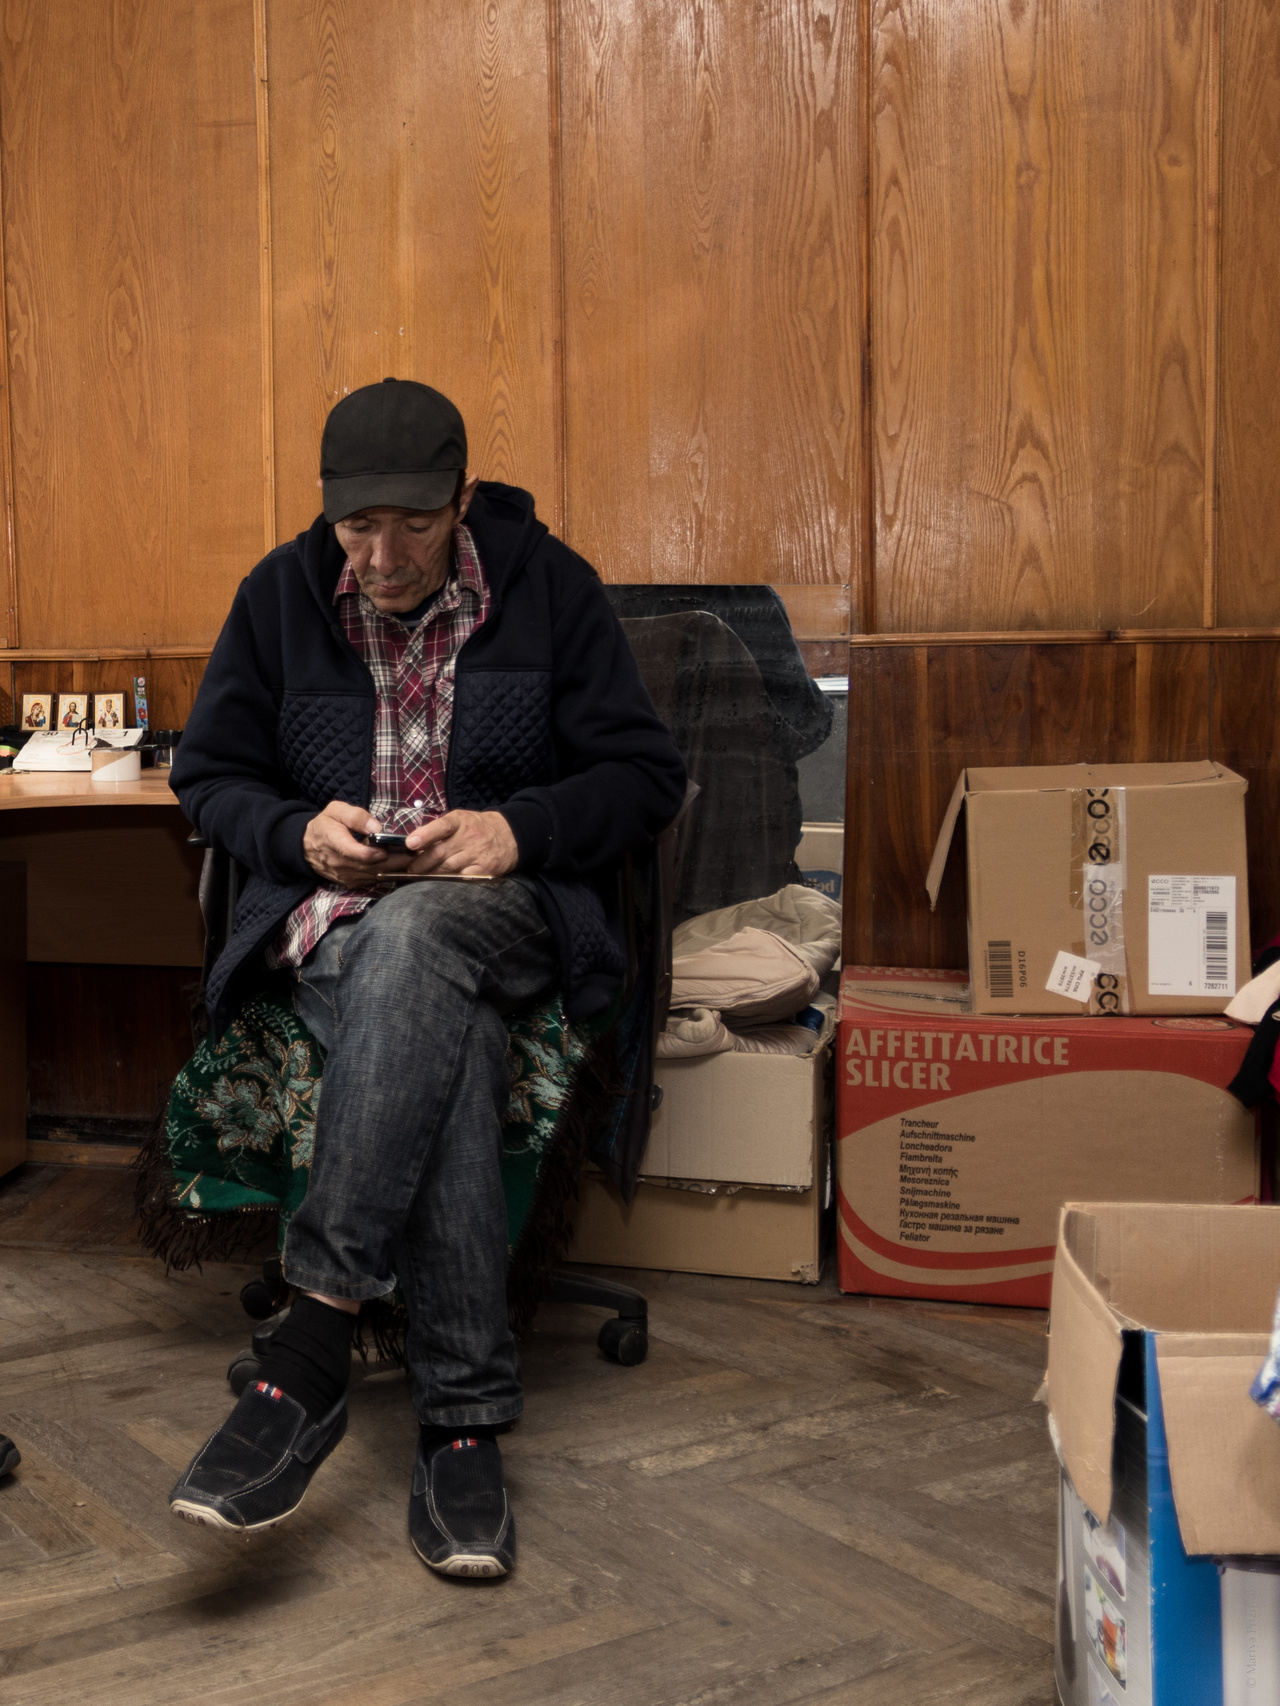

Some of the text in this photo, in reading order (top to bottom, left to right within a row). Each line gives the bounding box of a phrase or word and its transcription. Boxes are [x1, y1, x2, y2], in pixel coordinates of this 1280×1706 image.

[1089, 880, 1108, 945] ecco
[1018, 951, 1027, 988] D16P06
[845, 1028, 1069, 1066] AFFETTATRICE
[846, 1058, 951, 1091] SLICER
[900, 1118, 939, 1129] Trancheur
[900, 1130, 976, 1142] Aufschnittmaschine
[900, 1141, 952, 1152] Loncheadora
[900, 1175, 949, 1186] Mesoreznica
[900, 1187, 951, 1197] Snijmachine
[900, 1209, 1019, 1225] Кухонная резальная машина
[900, 1219, 926, 1230] Гастро
[928, 1223, 961, 1232] машина
[975, 1226, 1004, 1235] рязане
[900, 1231, 930, 1242] Feliator
